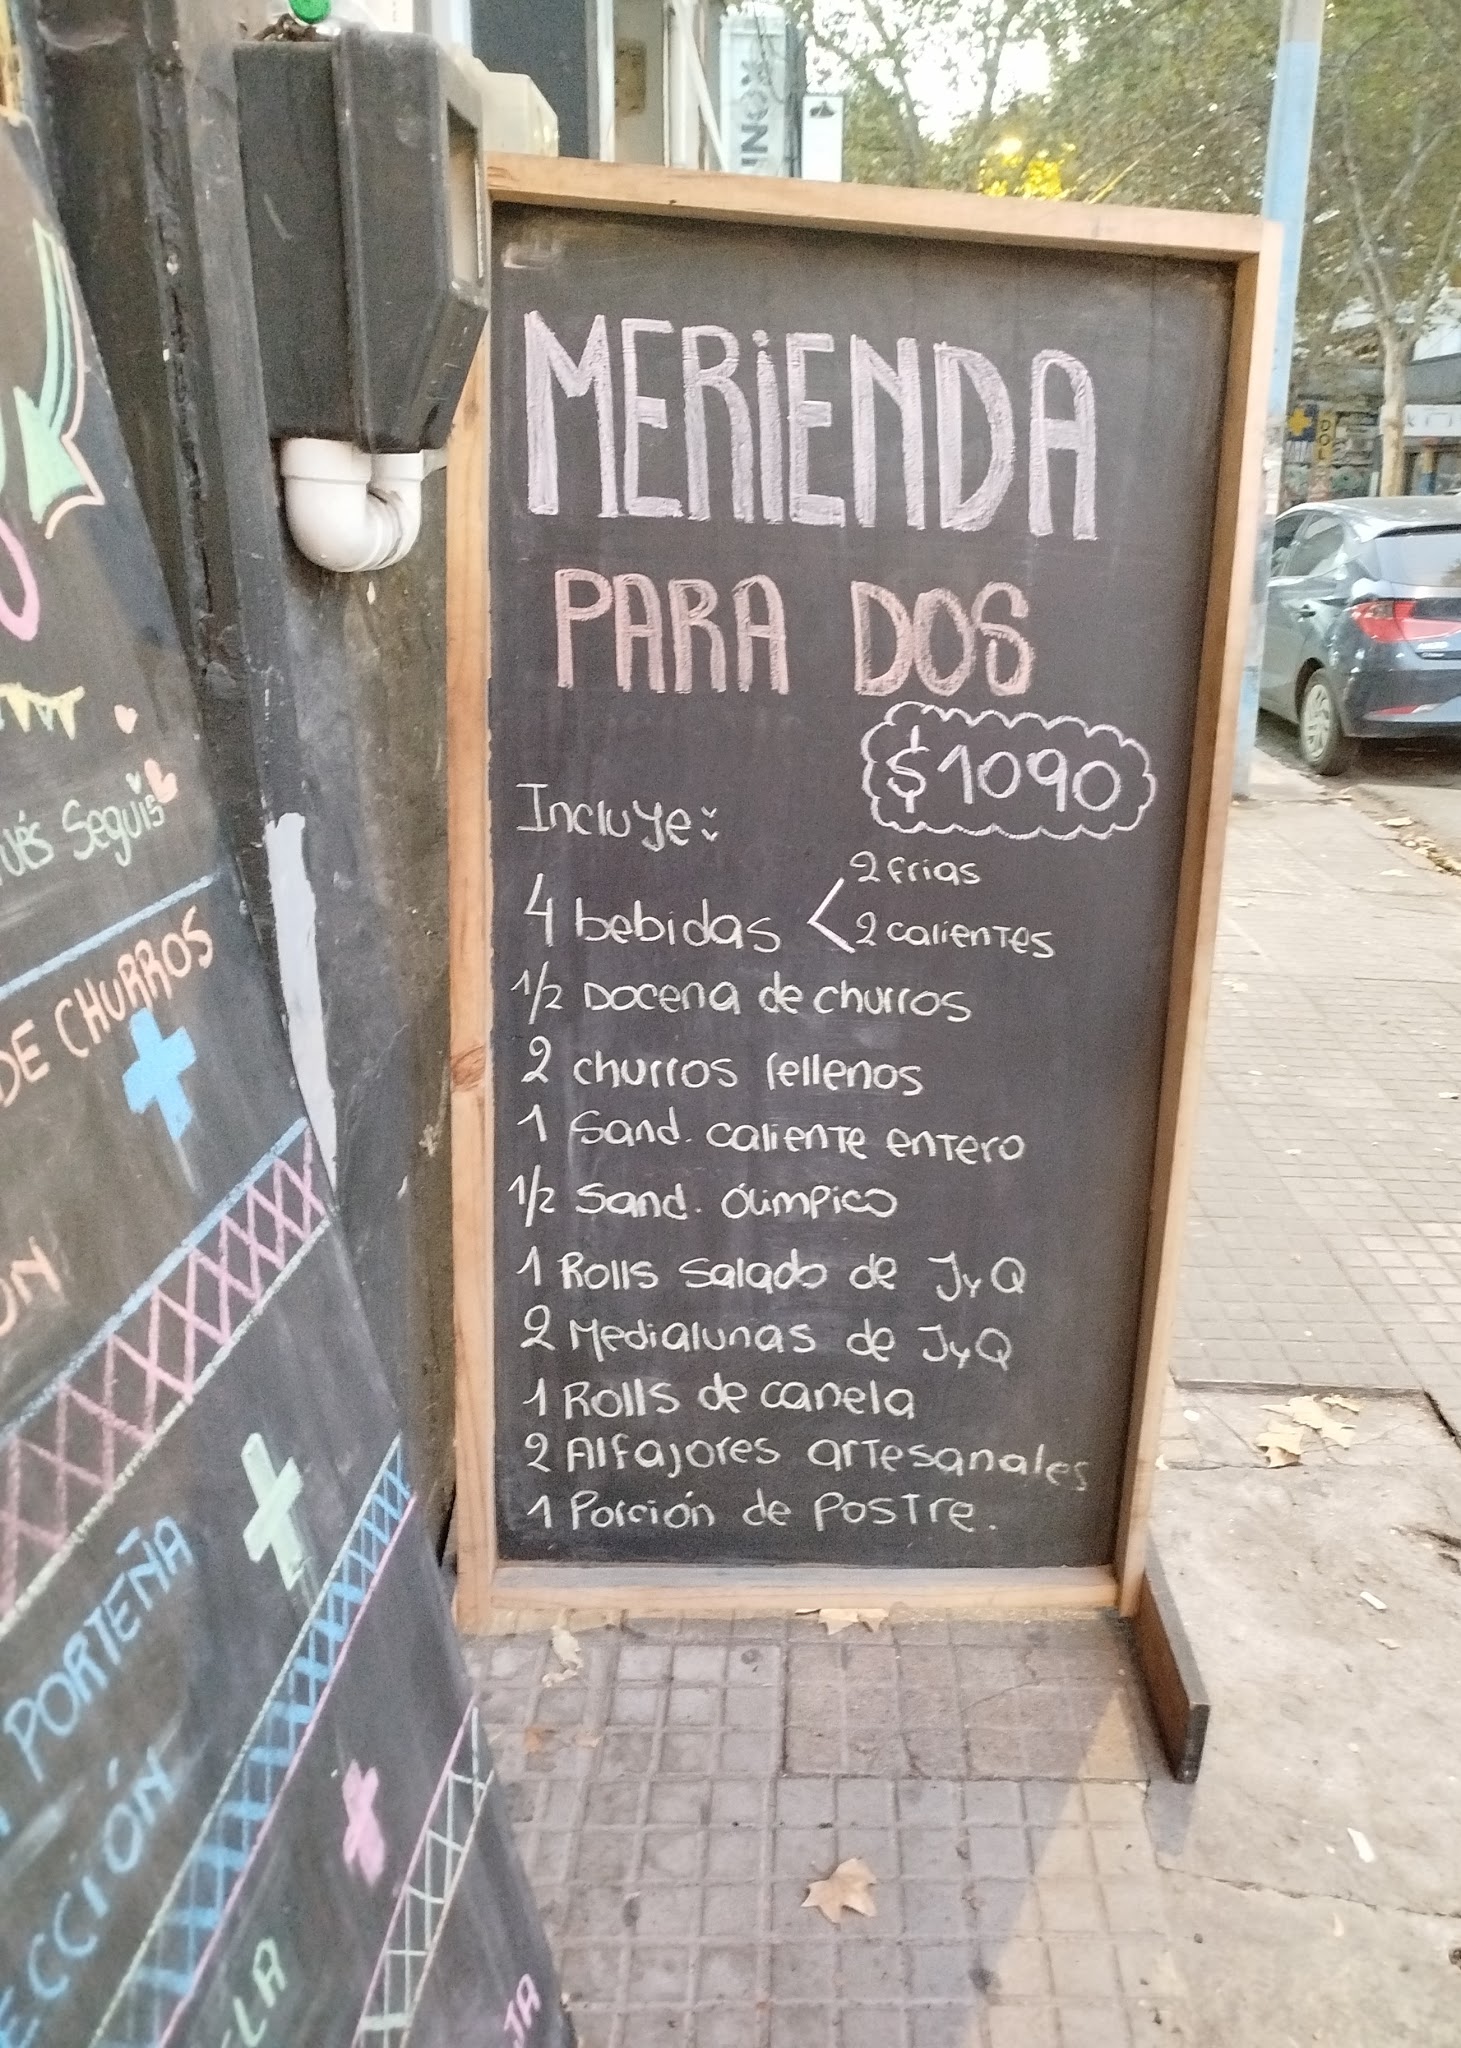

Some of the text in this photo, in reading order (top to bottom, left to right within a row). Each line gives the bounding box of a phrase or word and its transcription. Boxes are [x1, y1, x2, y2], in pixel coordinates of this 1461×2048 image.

[554, 568, 1037, 697] PARA DOS
[886, 724, 1122, 814] $1090
[849, 850, 881, 883] 2
[523, 872, 781, 953] 4 bebidas
[855, 911, 1056, 959] 2 calientes
[54, 904, 214, 1058] CHURROS
[510, 960, 564, 1025] 1/2
[757, 970, 804, 1015] de
[812, 979, 972, 1023] churros
[520, 1035, 552, 1084] 2
[572, 1049, 739, 1089] churros
[516, 1103, 548, 1143] 1
[705, 1122, 869, 1160] caliente
[885, 1127, 1026, 1165] entero
[507, 1164, 556, 1228] 1/2
[515, 1245, 542, 1287] 1
[556, 1251, 660, 1291] Rolls
[848, 1252, 898, 1291] de
[519, 1304, 556, 1351] 2
[569, 1317, 818, 1363] Medialunas
[845, 1317, 896, 1363] de
[522, 1371, 915, 1421] 1 Rolls de canela
[524, 1432, 1089, 1492] 2 Alfajores artesanales
[526, 1494, 553, 1529] 1
[741, 1487, 792, 1527] de
[4, 1516, 194, 1783] PORTEÑA
[222, 1937, 287, 2048] LA
